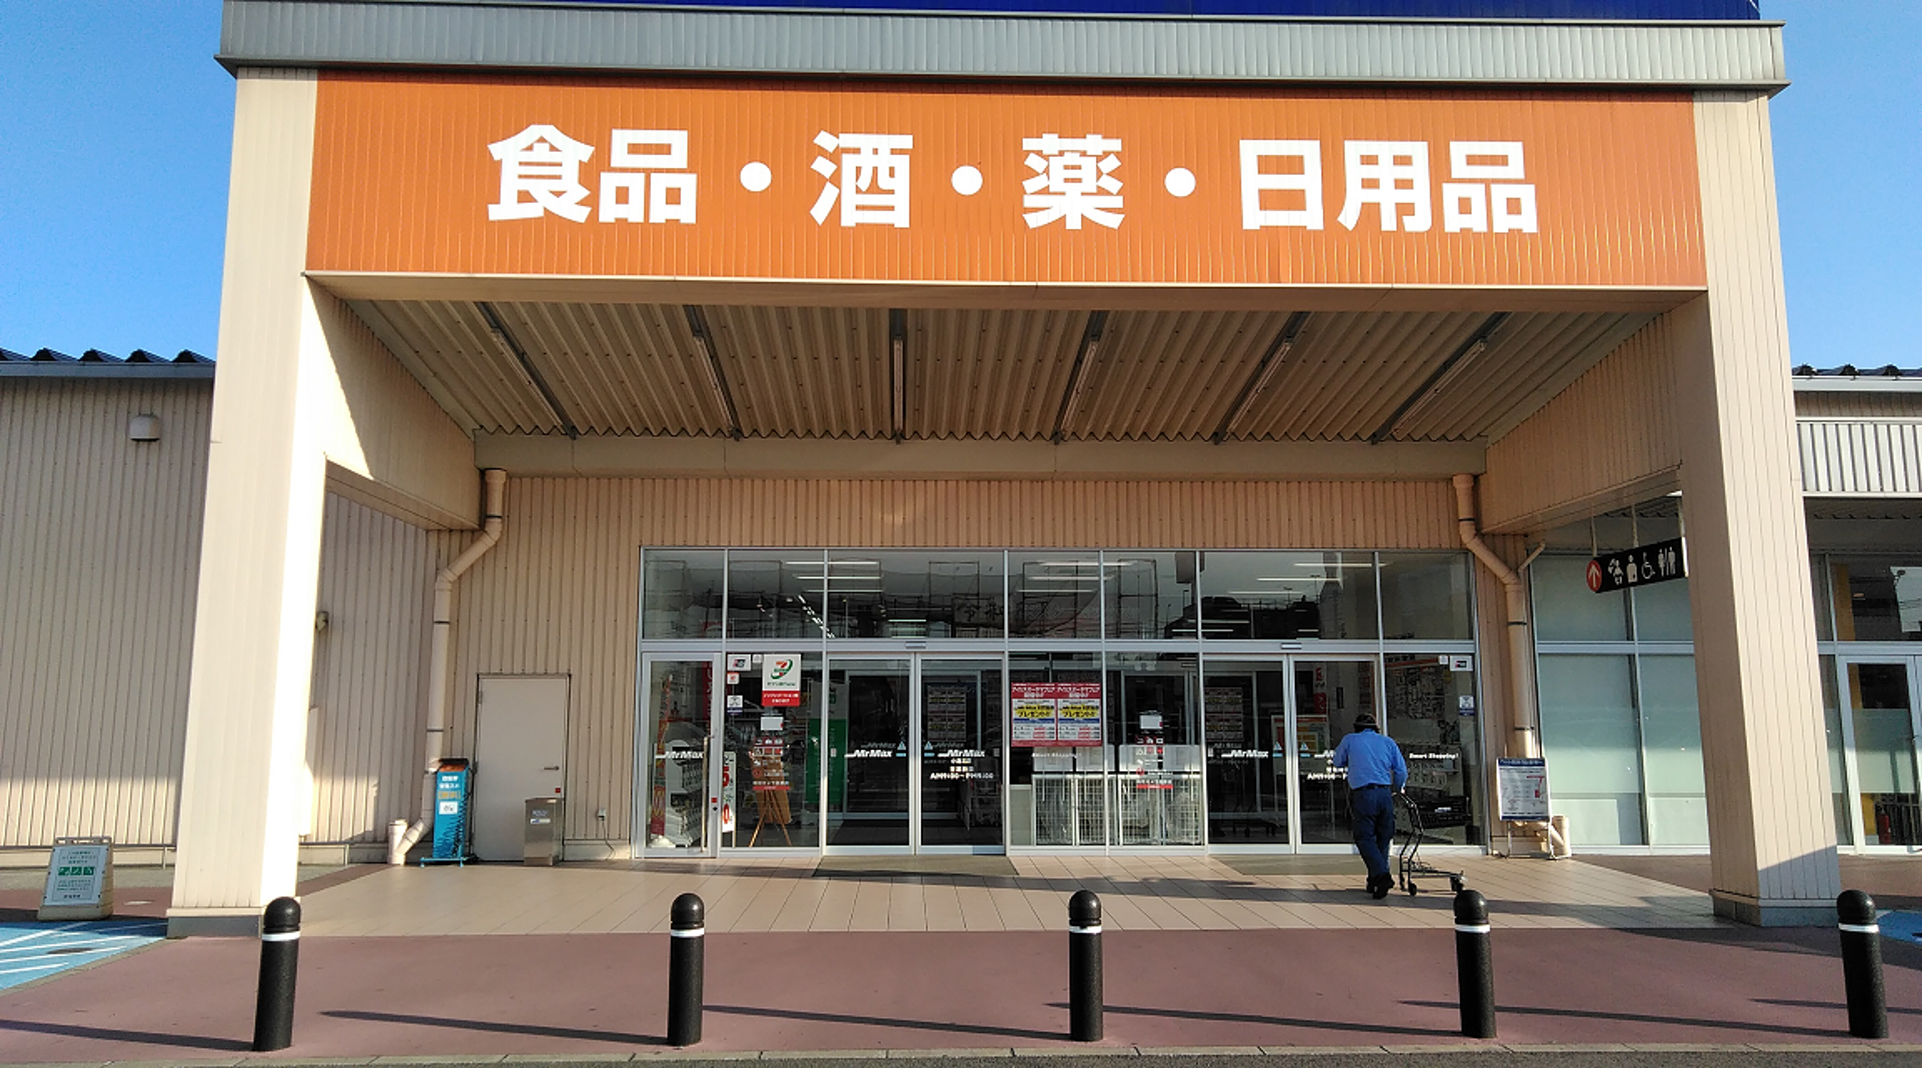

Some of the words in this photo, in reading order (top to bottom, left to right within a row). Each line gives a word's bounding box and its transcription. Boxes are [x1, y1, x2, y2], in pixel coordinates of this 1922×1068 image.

[487, 124, 1538, 233] 食品・酒・薬・日用品
